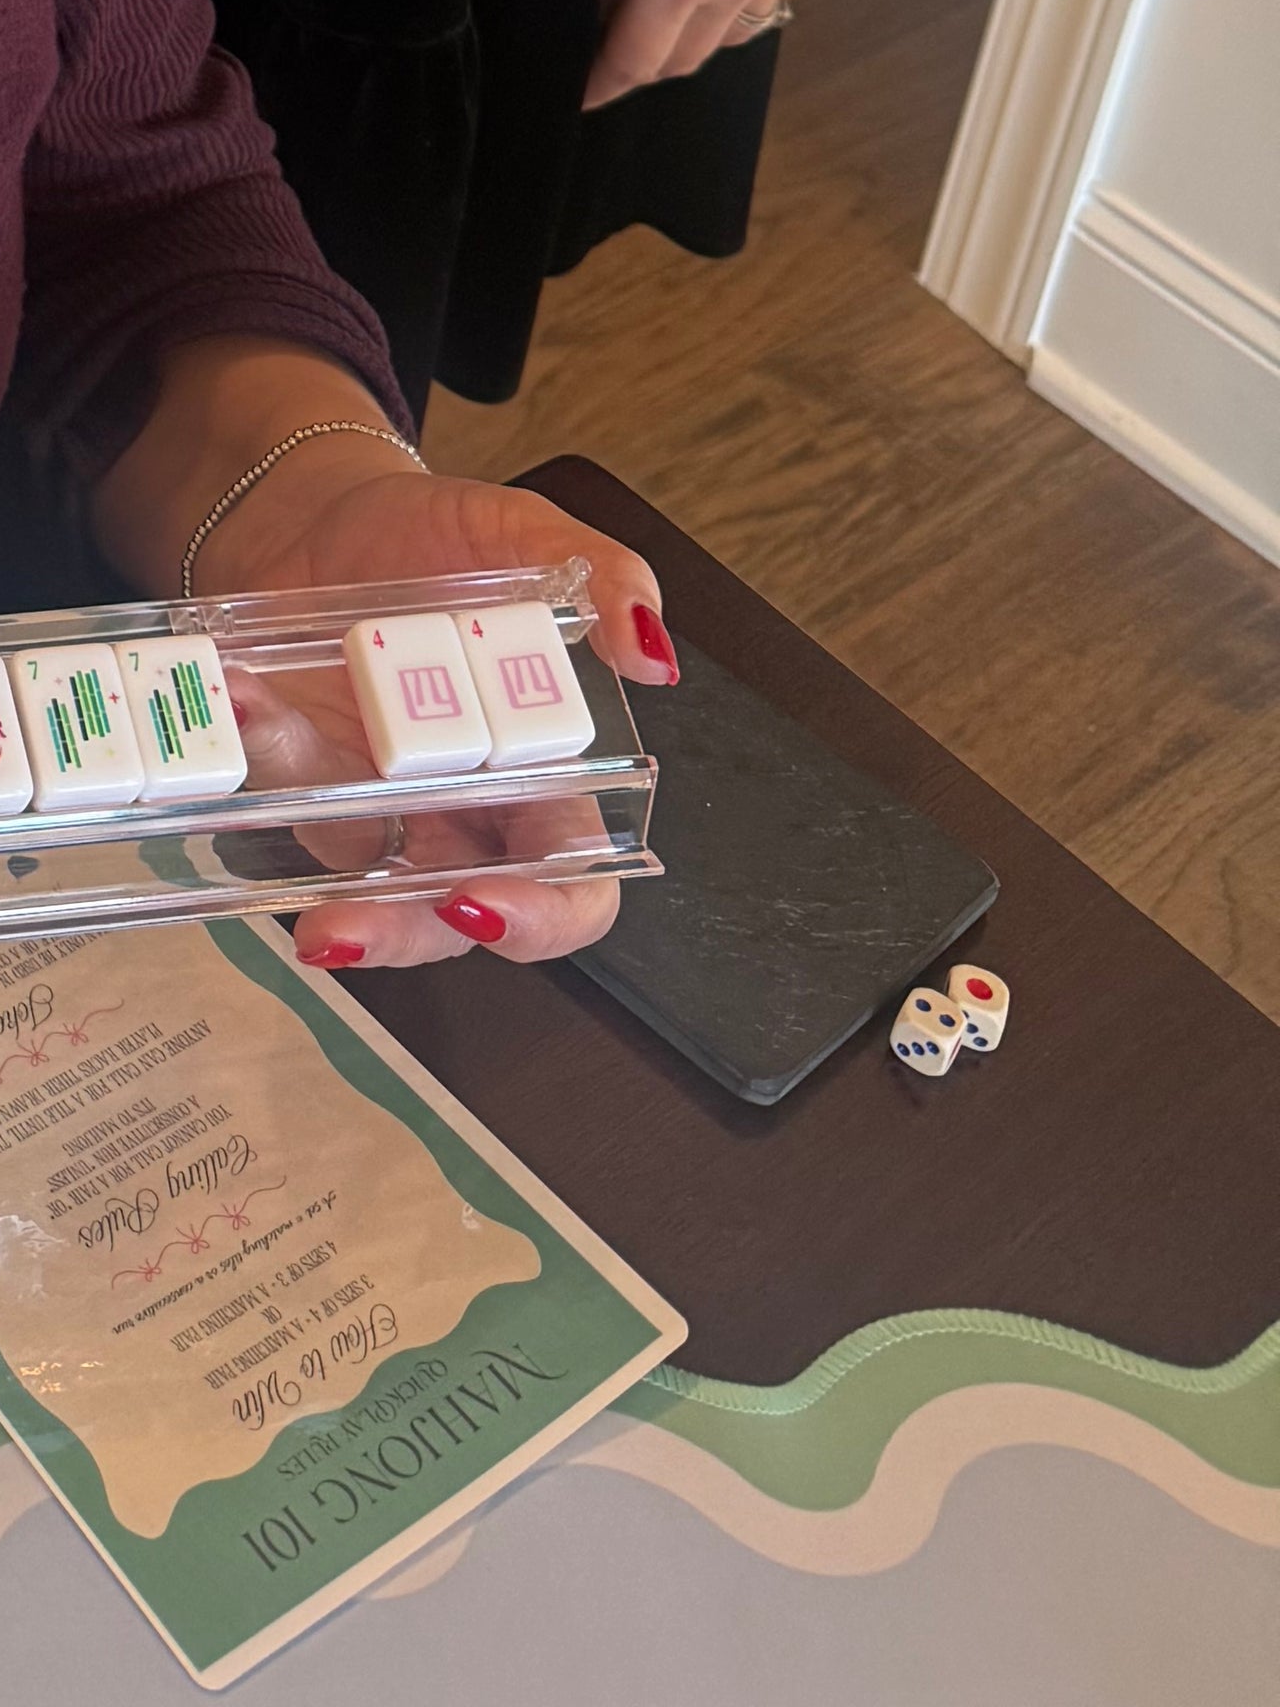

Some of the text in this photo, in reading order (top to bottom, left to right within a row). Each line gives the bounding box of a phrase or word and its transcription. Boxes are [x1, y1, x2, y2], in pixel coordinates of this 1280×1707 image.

[373, 629, 384, 648] 4
[471, 619, 483, 637] 4
[27, 661, 38, 680] 7
[129, 652, 139, 671] 7
[398, 666, 462, 720] 四
[498, 653, 563, 709] 四
[7, 946, 20, 959] A
[37, 948, 57, 966] BE
[54, 934, 86, 957] ONLY
[11, 957, 42, 979] USED
[114, 1022, 163, 1055] PLAYER
[161, 1019, 211, 1056] ANYONE
[76, 1046, 119, 1077] RACKS
[137, 1047, 166, 1070] CAN
[40, 1068, 82, 1096] THEIR
[106, 1062, 141, 1086] CALL
[69, 1091, 85, 1106] A
[82, 1078, 111, 1100] FOR
[42, 1099, 76, 1123] TILE
[185, 1094, 201, 1109] A
[116, 1108, 137, 1126] TO
[116, 1102, 190, 1151] CONSECUTIVE
[204, 1103, 233, 1127] YOU
[5, 1114, 48, 1141] UNTIL
[61, 1117, 120, 1157] MAHJONG
[160, 1118, 207, 1153] CANNOT
[92, 1142, 121, 1166] RUN
[129, 1144, 163, 1169] CALL
[95, 1173, 109, 1188] A
[106, 1160, 135, 1183] FOR
[67, 1179, 101, 1205] PAIR
[77, 1134, 257, 1251] Calling Rules
[321, 1189, 336, 1210] A
[304, 1200, 321, 1218] set
[241, 1219, 293, 1255] matching
[324, 1240, 337, 1255] 4
[219, 1251, 243, 1272] tiles
[299, 1244, 331, 1271] SETS
[274, 1271, 290, 1287] 3
[285, 1262, 304, 1281] OF
[359, 1273, 374, 1289] 3
[134, 1281, 193, 1321] consecutive
[254, 1282, 271, 1298] A
[333, 1280, 365, 1306] SETS
[197, 1289, 261, 1336] MATCHING
[259, 1305, 282, 1324] OR
[308, 1308, 322, 1323] 4
[320, 1297, 339, 1318] OF
[288, 1317, 304, 1334] A
[169, 1325, 203, 1352] PAIR
[231, 1326, 296, 1372] MATCHING
[202, 1362, 237, 1389] PAIR
[232, 1303, 398, 1430] How to Win
[241, 1344, 566, 1571] MAHJONG 101
[276, 1431, 340, 1481] RULES
